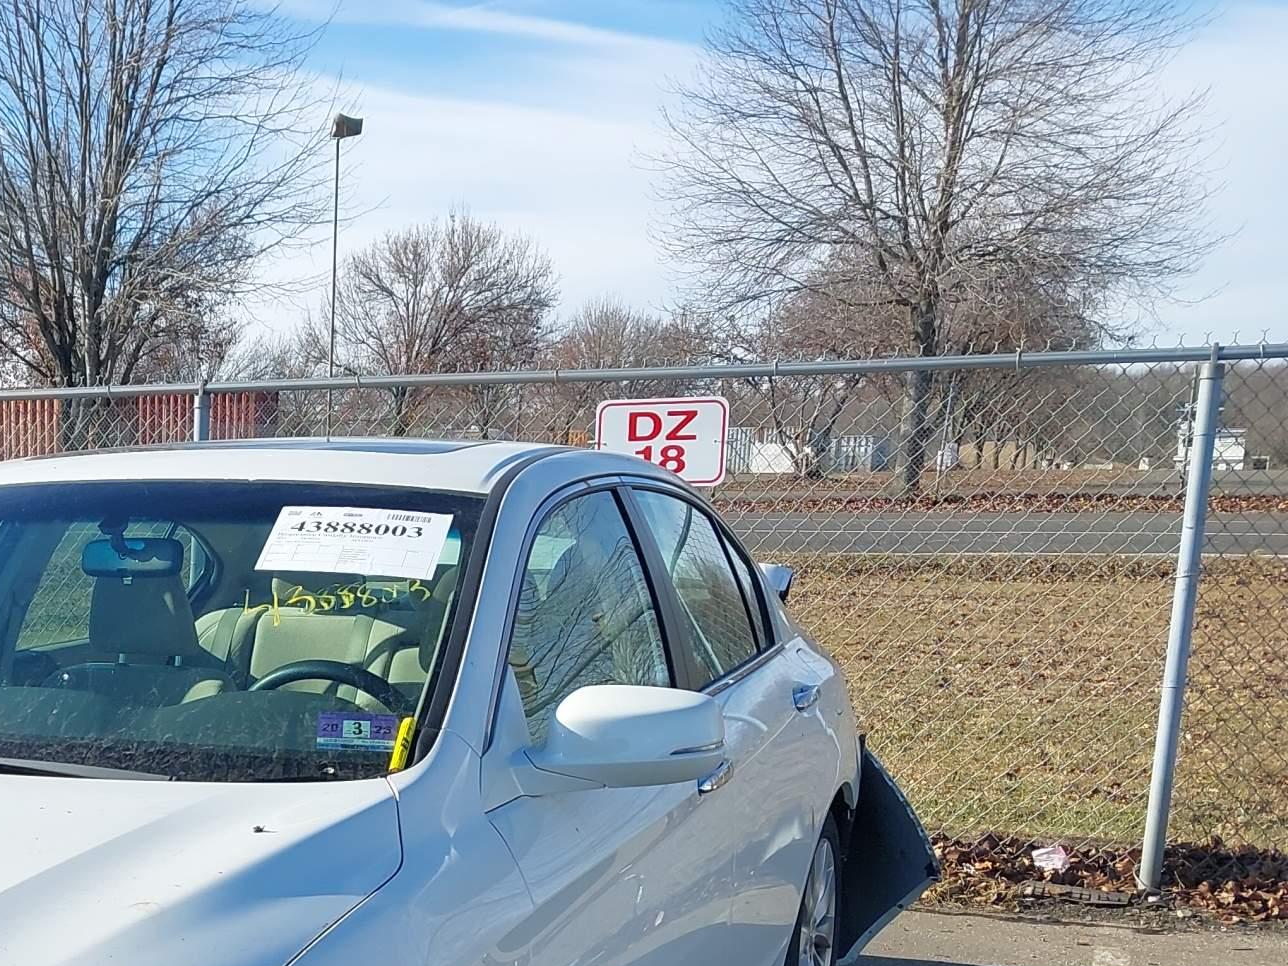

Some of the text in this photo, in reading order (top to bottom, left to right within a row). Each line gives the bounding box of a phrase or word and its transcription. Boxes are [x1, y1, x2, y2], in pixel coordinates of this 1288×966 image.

[627, 409, 698, 442] DZ
[289, 519, 424, 539] 43888003
[352, 721, 363, 736] 3
